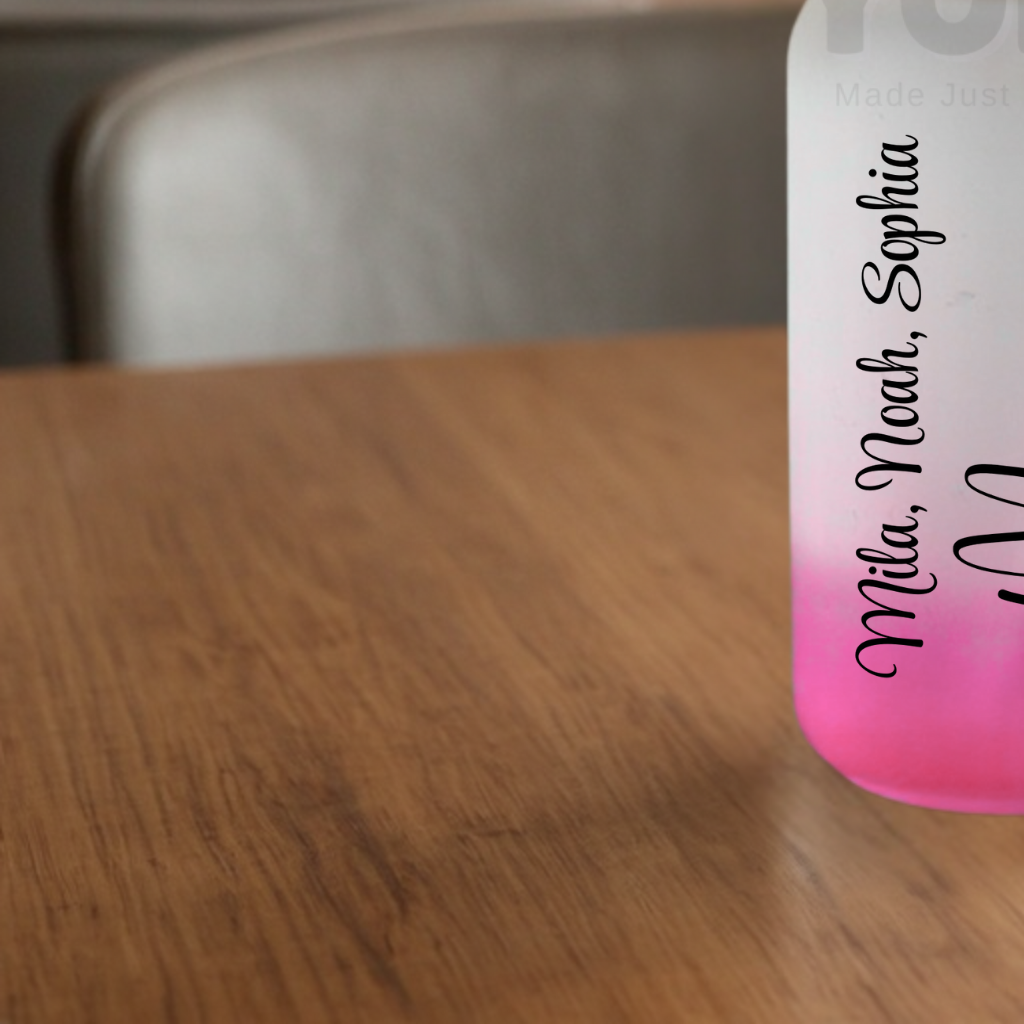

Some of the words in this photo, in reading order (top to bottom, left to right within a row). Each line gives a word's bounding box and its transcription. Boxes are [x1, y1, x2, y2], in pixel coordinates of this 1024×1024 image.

[856, 134, 947, 312] Sophia
[855, 331, 928, 491] Noah,
[855, 504, 938, 678] Mila,
